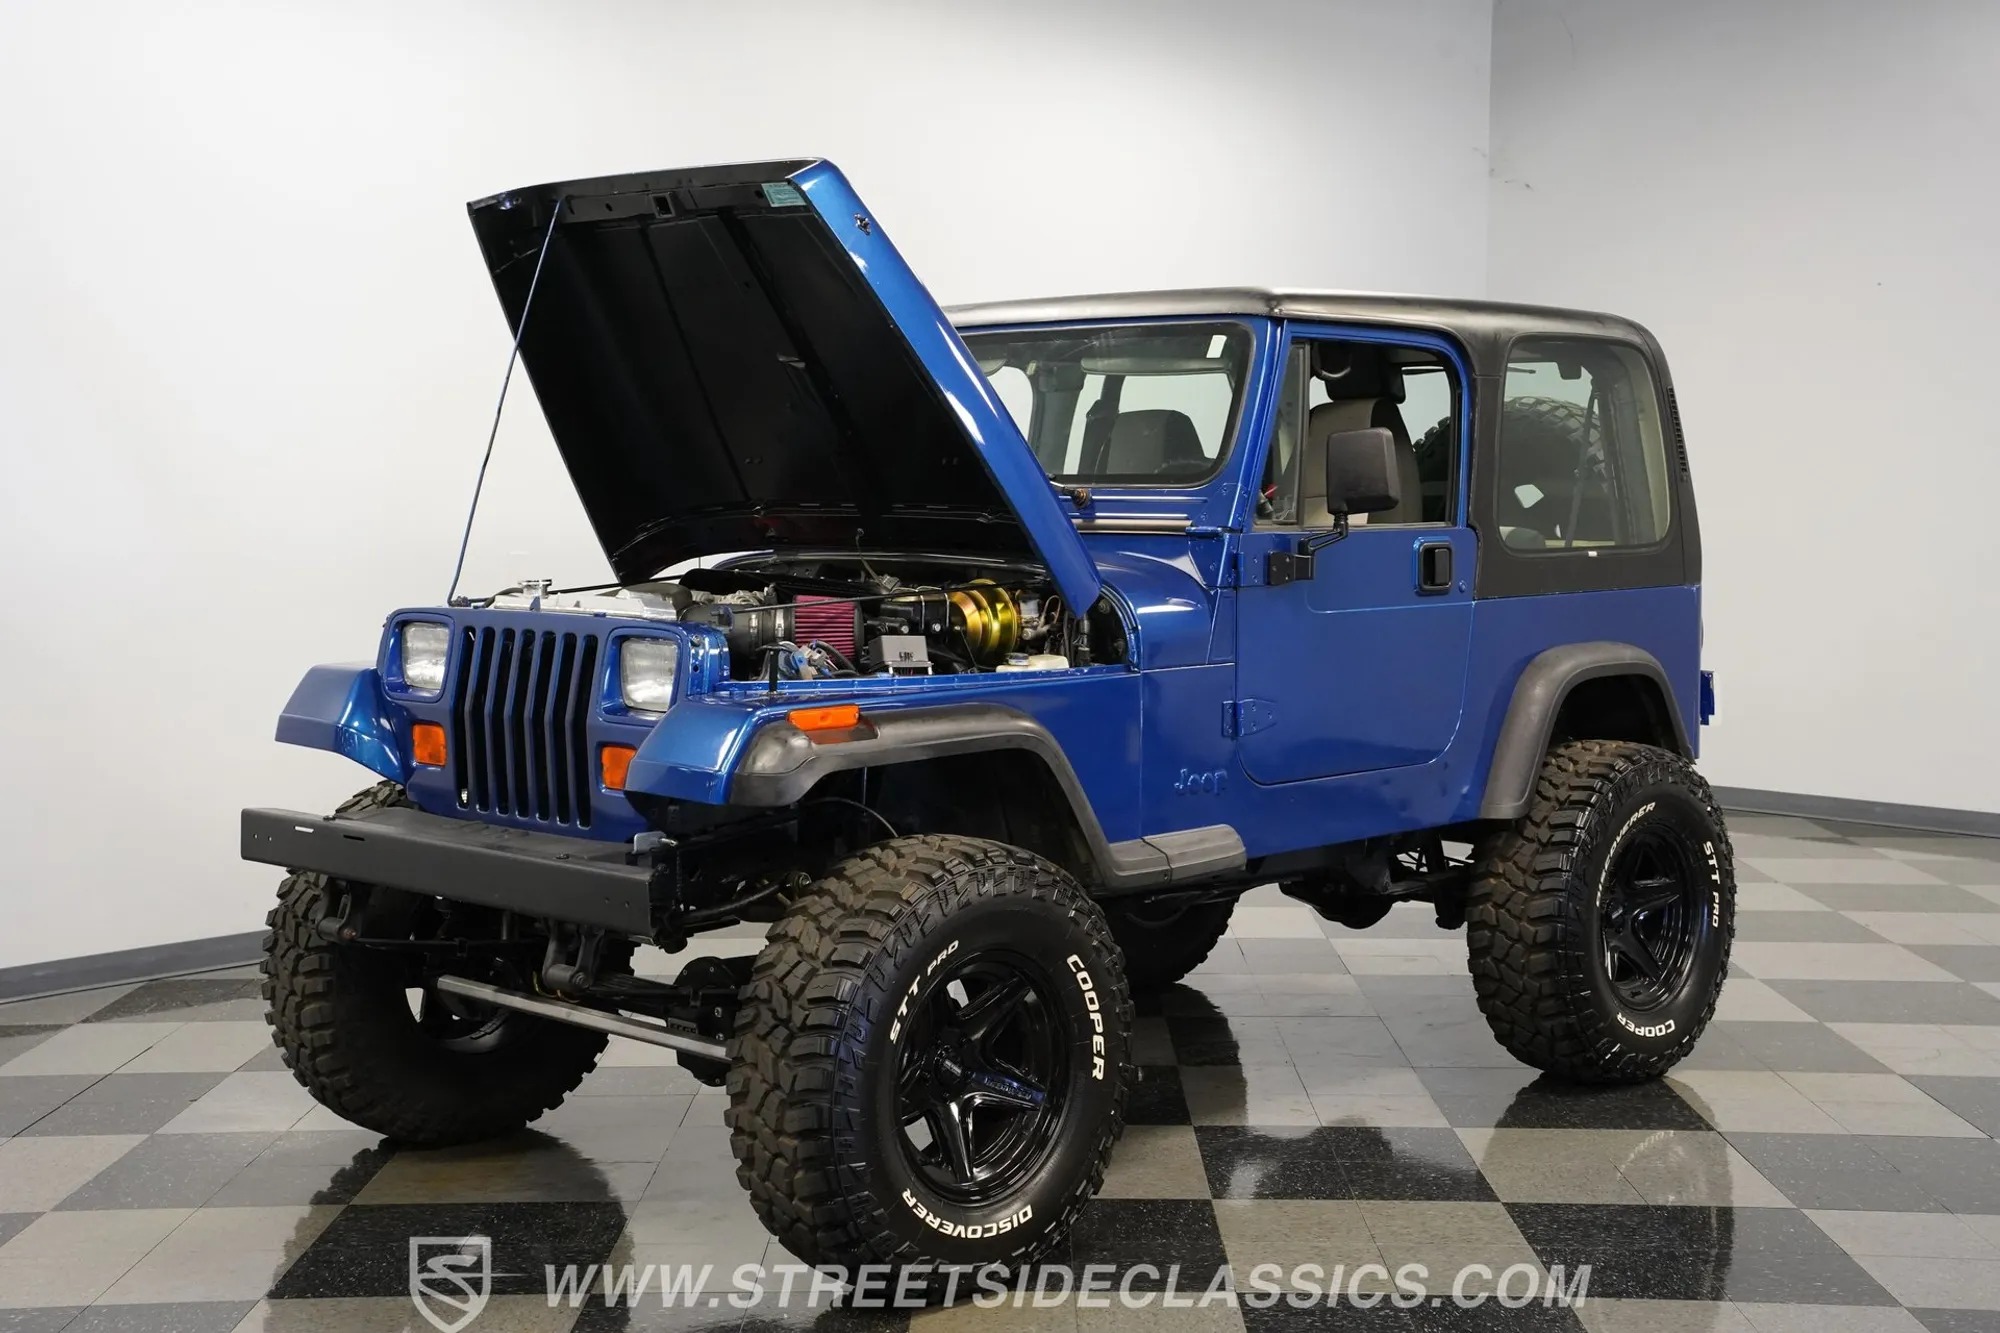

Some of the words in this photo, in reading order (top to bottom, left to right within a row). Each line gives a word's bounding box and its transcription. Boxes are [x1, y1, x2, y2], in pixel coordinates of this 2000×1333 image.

[1174, 767, 1229, 796] Jeep
[1703, 840, 1720, 885] STT
[1712, 890, 1720, 928] PRO
[889, 974, 921, 1045] STT
[927, 939, 960, 977] PRO
[1066, 953, 1105, 1081] COOPER
[1616, 1011, 1676, 1038] COOPER
[901, 1187, 1033, 1239] DISCOVERER
